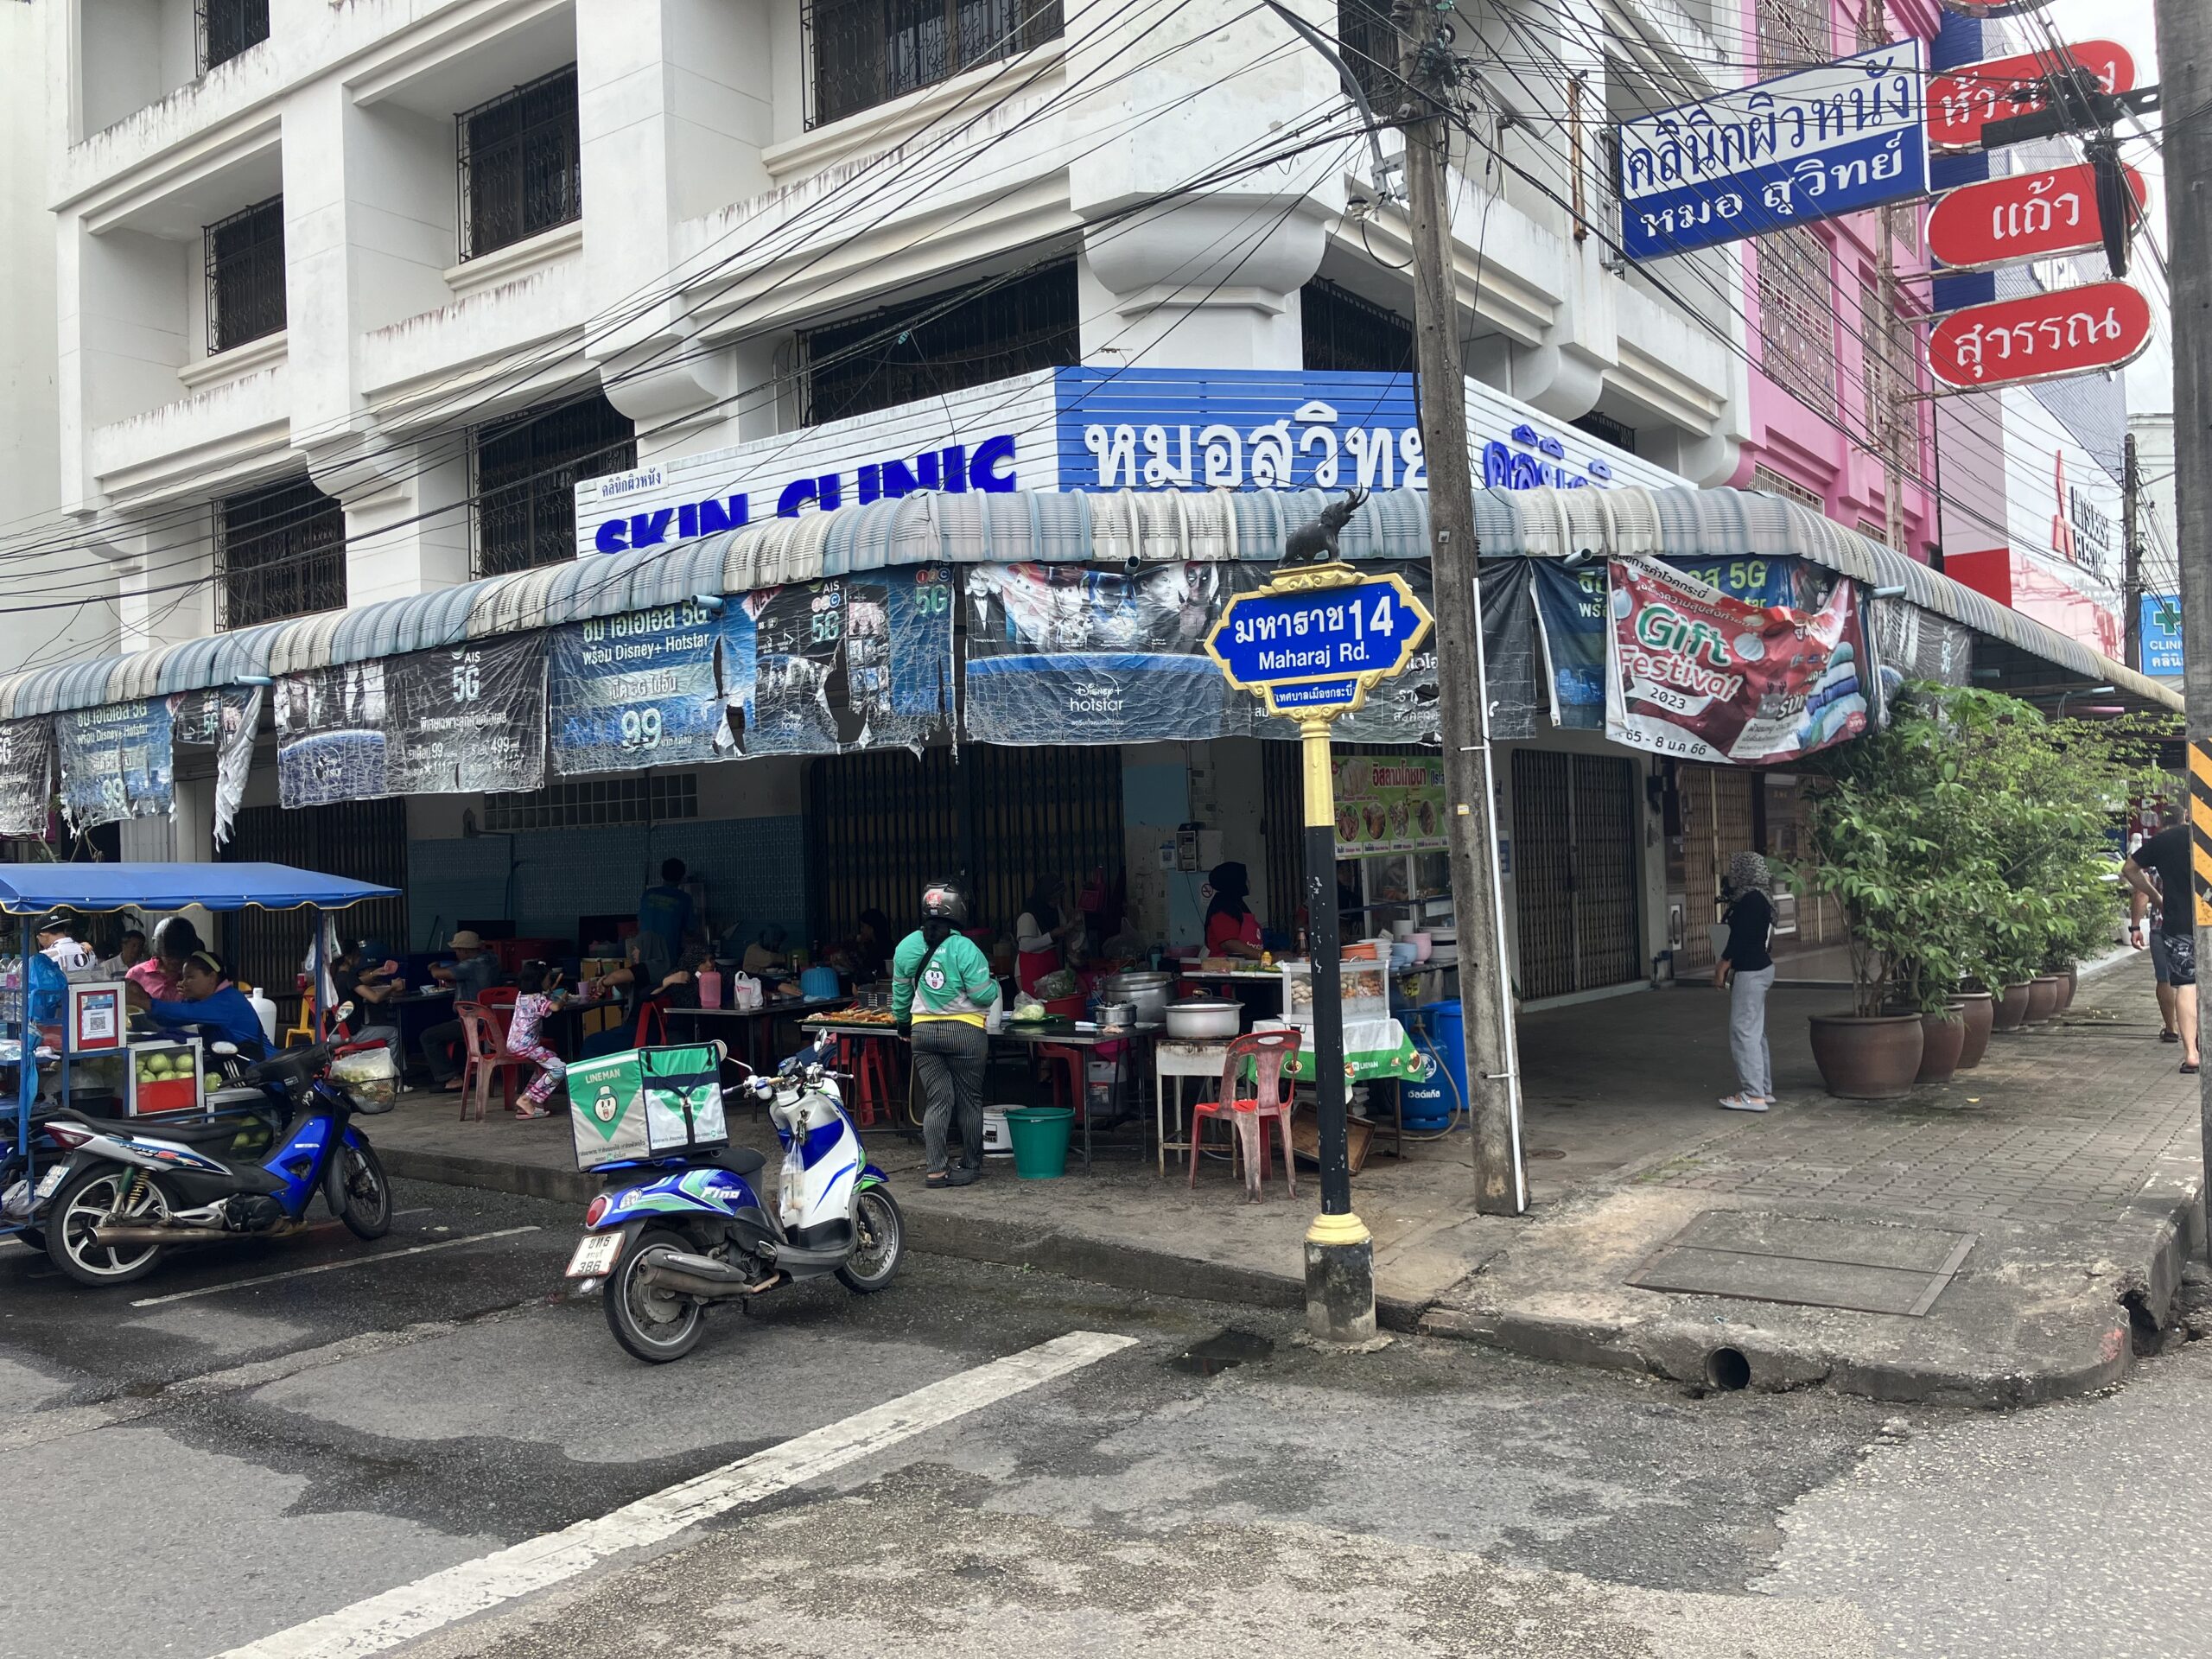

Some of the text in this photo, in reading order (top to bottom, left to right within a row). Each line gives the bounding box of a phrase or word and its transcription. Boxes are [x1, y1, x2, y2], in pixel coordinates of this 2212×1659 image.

[1628, 57, 1910, 192] คลินิกผิวหนัง
[1641, 136, 1902, 237] หมอ สุวิทย์
[1955, 308, 2121, 378] สุวรรณ
[595, 435, 1016, 554] SKIN CLINIC
[602, 467, 661, 497] คลินิกผิวหนัง
[823, 581, 839, 594] AIS
[1730, 561, 1766, 588] 5G
[915, 584, 948, 613] 5G
[682, 601, 708, 626] 5G
[811, 611, 839, 642] 5G
[1235, 596, 1394, 645] มหาราช 14
[1636, 602, 1732, 666] Gift
[2150, 640, 2183, 651] CLINI
[464, 652, 480, 663] AIS
[582, 633, 709, 665] พร้อม Disney+ Hotstar
[1259, 642, 1370, 670] Maharaj Rd.
[2152, 652, 2183, 668] คลินิ
[453, 665, 480, 702] 5G
[1618, 644, 1744, 702] Festival
[1071, 697, 1123, 711] hotstar
[1275, 681, 1354, 702] เทศบาลเมืองกระบี่
[1650, 688, 1686, 709] 2023
[621, 709, 662, 753] 99
[1627, 730, 1641, 742] 65
[1656, 736, 1663, 747] 8
[1690, 744, 1707, 755] 66
[432, 742, 442, 759] 99
[491, 737, 509, 753] 499
[102, 779, 125, 810] 99
[578, 1261, 602, 1273] 386
